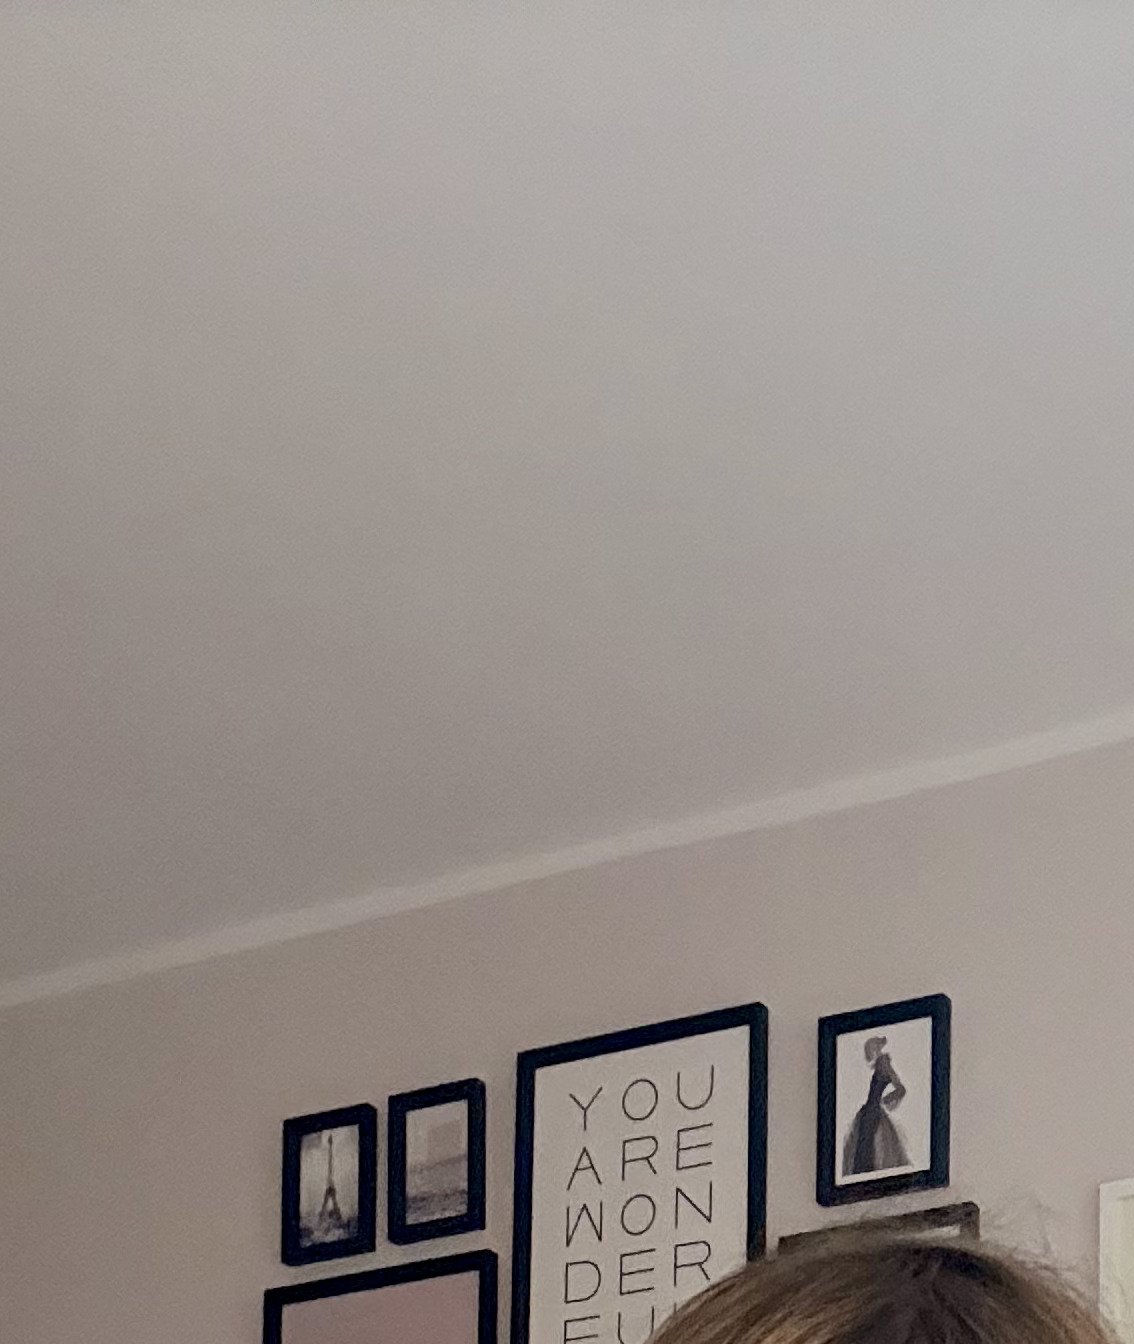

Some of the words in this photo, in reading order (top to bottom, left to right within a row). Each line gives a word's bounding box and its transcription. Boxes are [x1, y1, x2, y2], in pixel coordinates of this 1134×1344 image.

[569, 1064, 714, 1131] YOU
[567, 1122, 713, 1191] ARE
[566, 1180, 712, 1247] WON
[564, 1240, 711, 1304] DER
